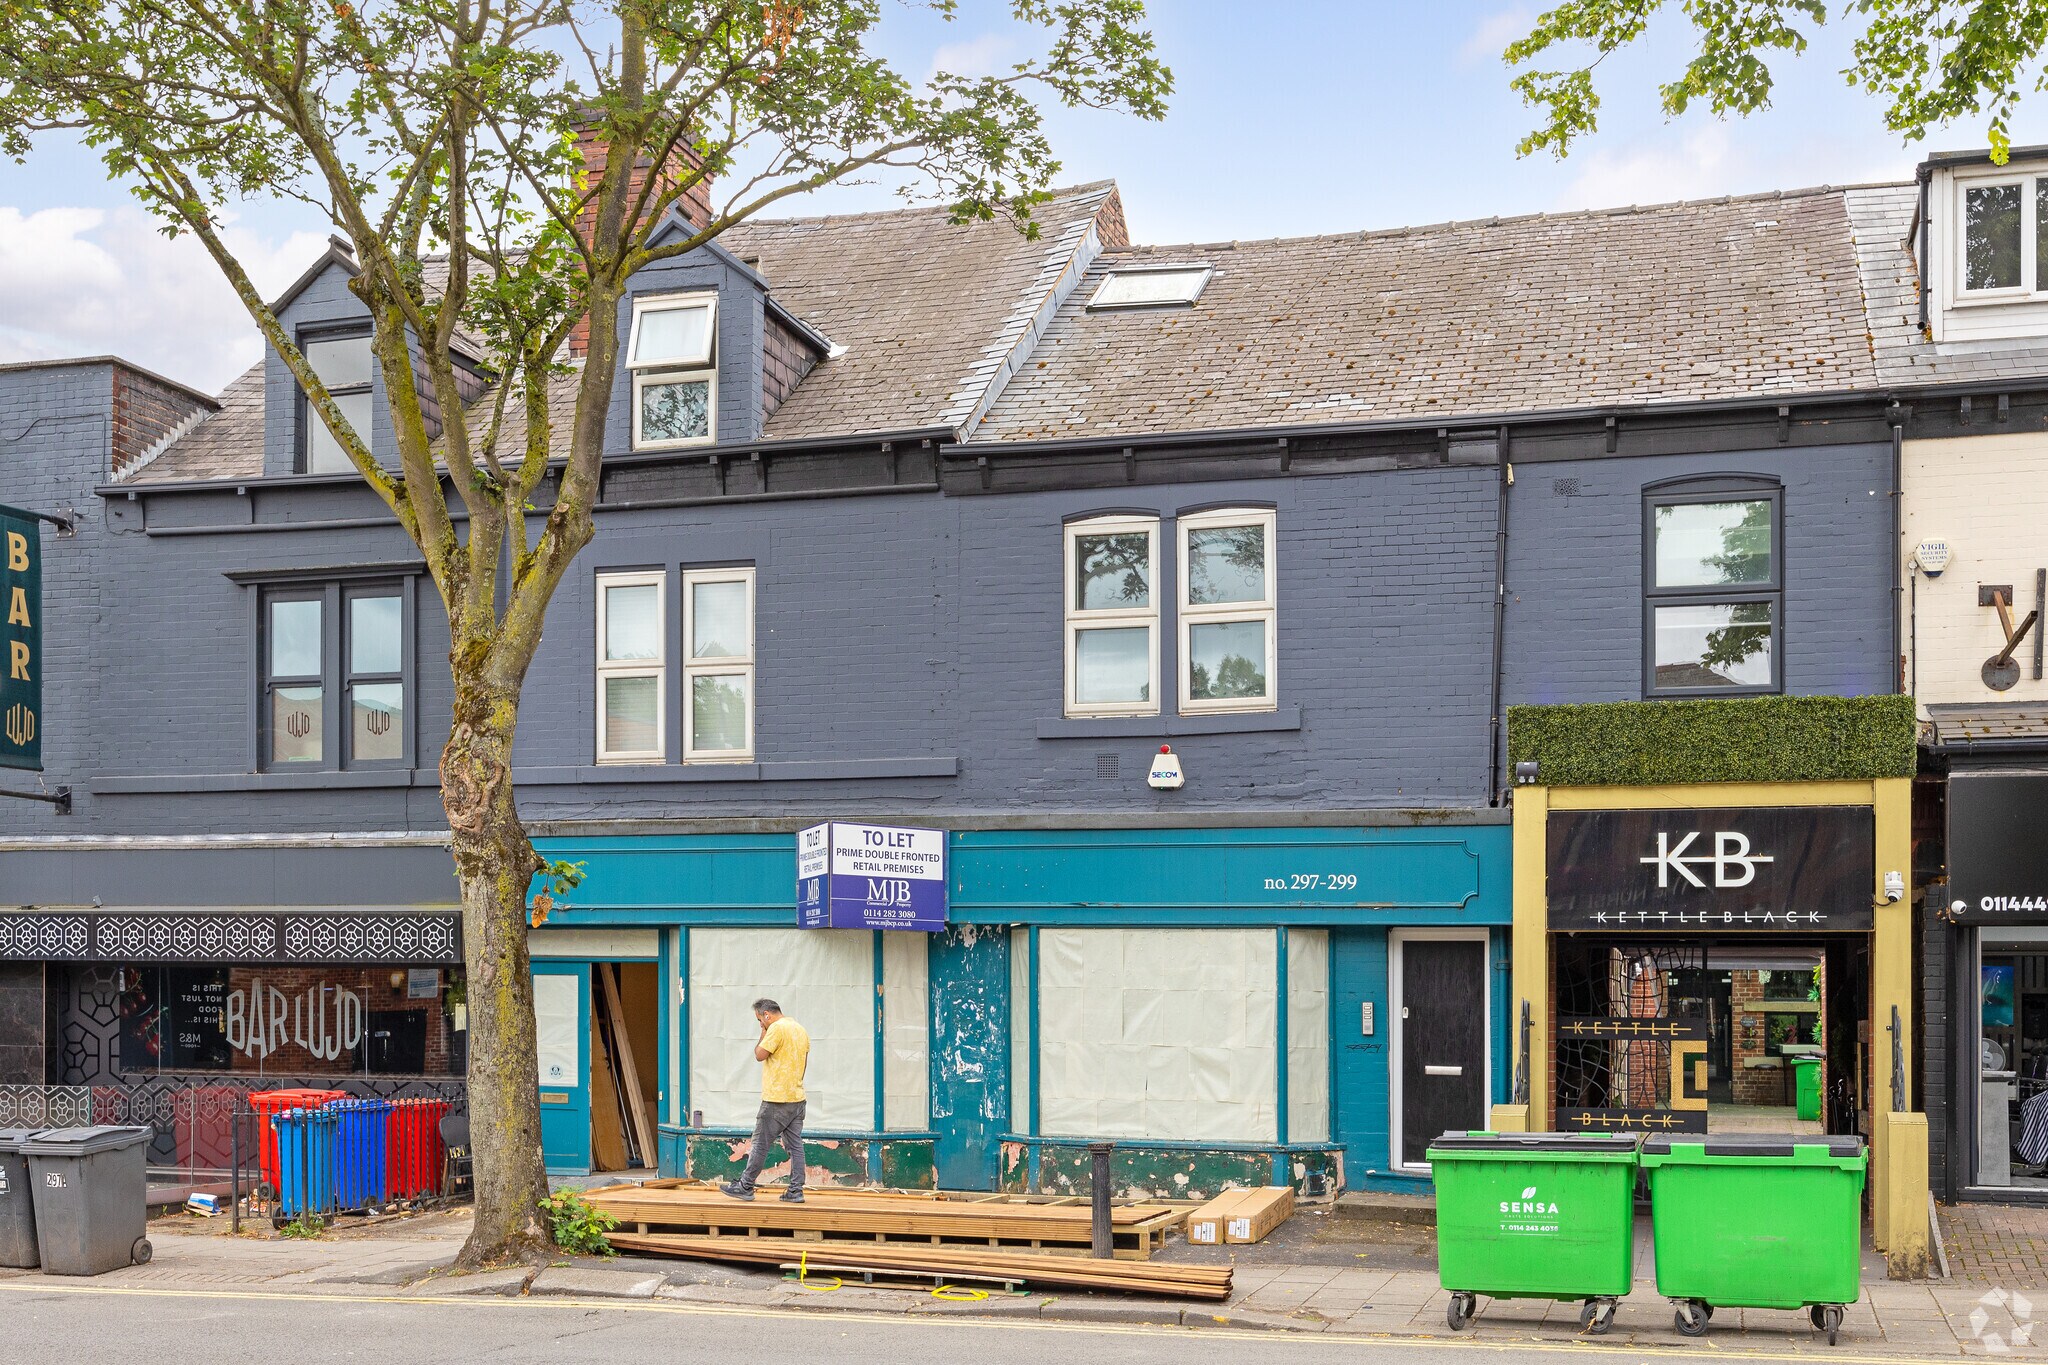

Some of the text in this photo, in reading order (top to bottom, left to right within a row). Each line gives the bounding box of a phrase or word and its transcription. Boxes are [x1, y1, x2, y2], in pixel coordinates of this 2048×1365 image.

[7, 531, 31, 681] BAR
[6, 703, 34, 746] LUJO
[287, 711, 310, 738] LUJO
[367, 709, 390, 736] LUJO
[806, 832, 812, 848] TO
[863, 830, 914, 848] TO LET
[836, 848, 940, 862] PRIME DOUBLE FRONTED
[1658, 831, 1755, 888] KB
[853, 861, 924, 874] RETAIL PREMISES
[1264, 874, 1357, 890] no. 297-299
[867, 878, 911, 906] MJB
[1981, 896, 2048, 911] 011444
[864, 909, 916, 919] 0114 282 3080
[226, 977, 361, 1061] BAR LUJO
[1574, 1021, 1679, 1036] KETTLE
[1582, 1112, 1672, 1128] BLACK
[1500, 1202, 1559, 1213] SENSA
